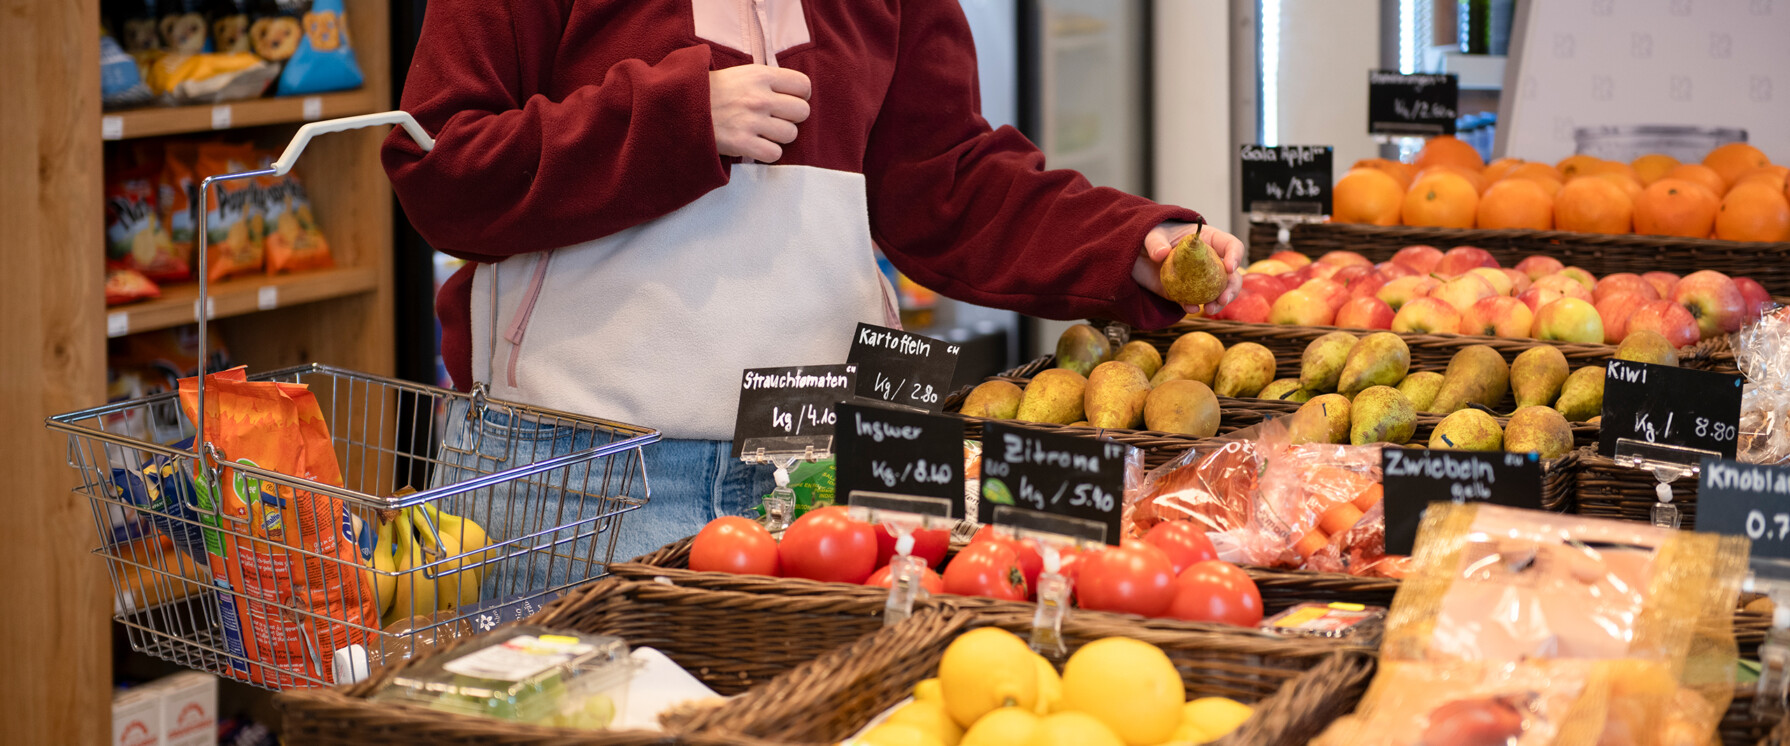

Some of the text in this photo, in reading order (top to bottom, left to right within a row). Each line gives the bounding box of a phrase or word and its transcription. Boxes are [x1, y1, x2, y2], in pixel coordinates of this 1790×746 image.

[859, 328, 960, 357] Kartoffeln CH
[743, 369, 847, 390] Strauchtomaten
[1607, 360, 1648, 384] Kiwi
[855, 411, 923, 443] Ingwer
[1694, 416, 1736, 442] 8.80
[1002, 433, 1100, 473] Zitrone
[1384, 449, 1495, 484] Zwiebeln
[1450, 482, 1492, 504] gelb
[1706, 462, 1790, 495] Knobla
